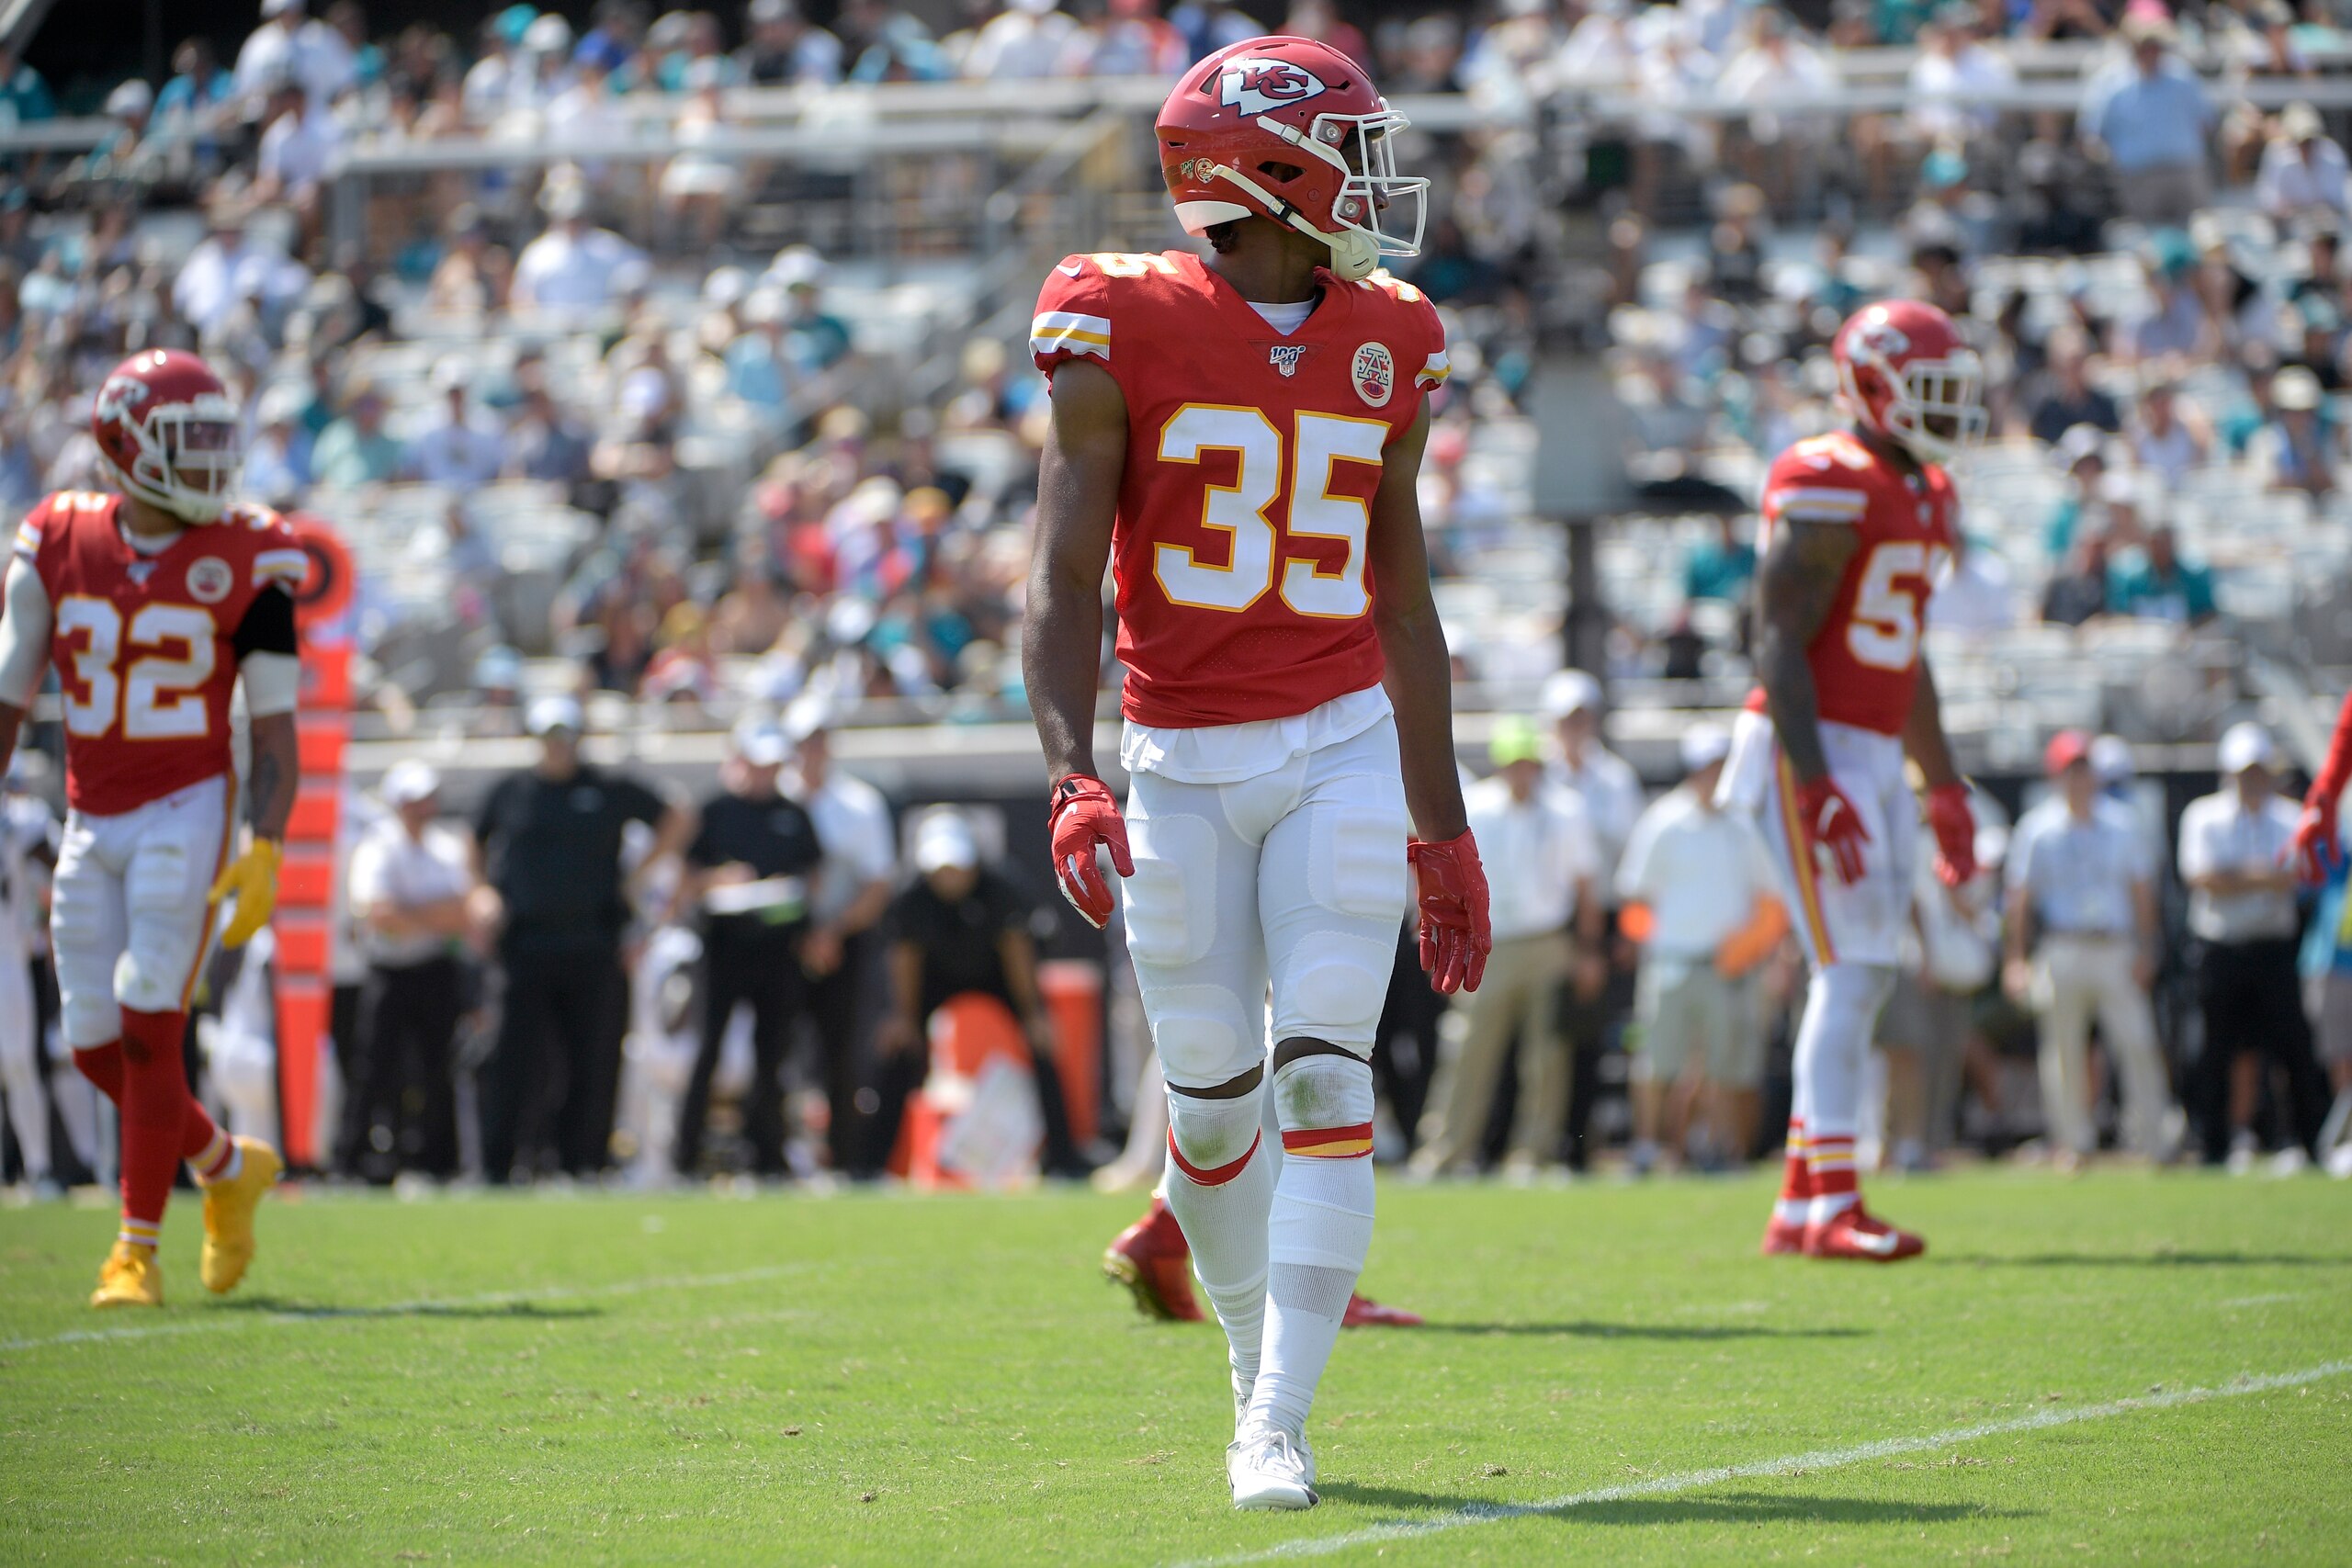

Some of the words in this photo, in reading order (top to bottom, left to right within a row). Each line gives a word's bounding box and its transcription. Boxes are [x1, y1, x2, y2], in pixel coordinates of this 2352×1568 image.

[1241, 66, 1308, 99] KC
[1357, 348, 1388, 386] A
[1152, 402, 1392, 619] 35
[56, 594, 217, 739] 32
